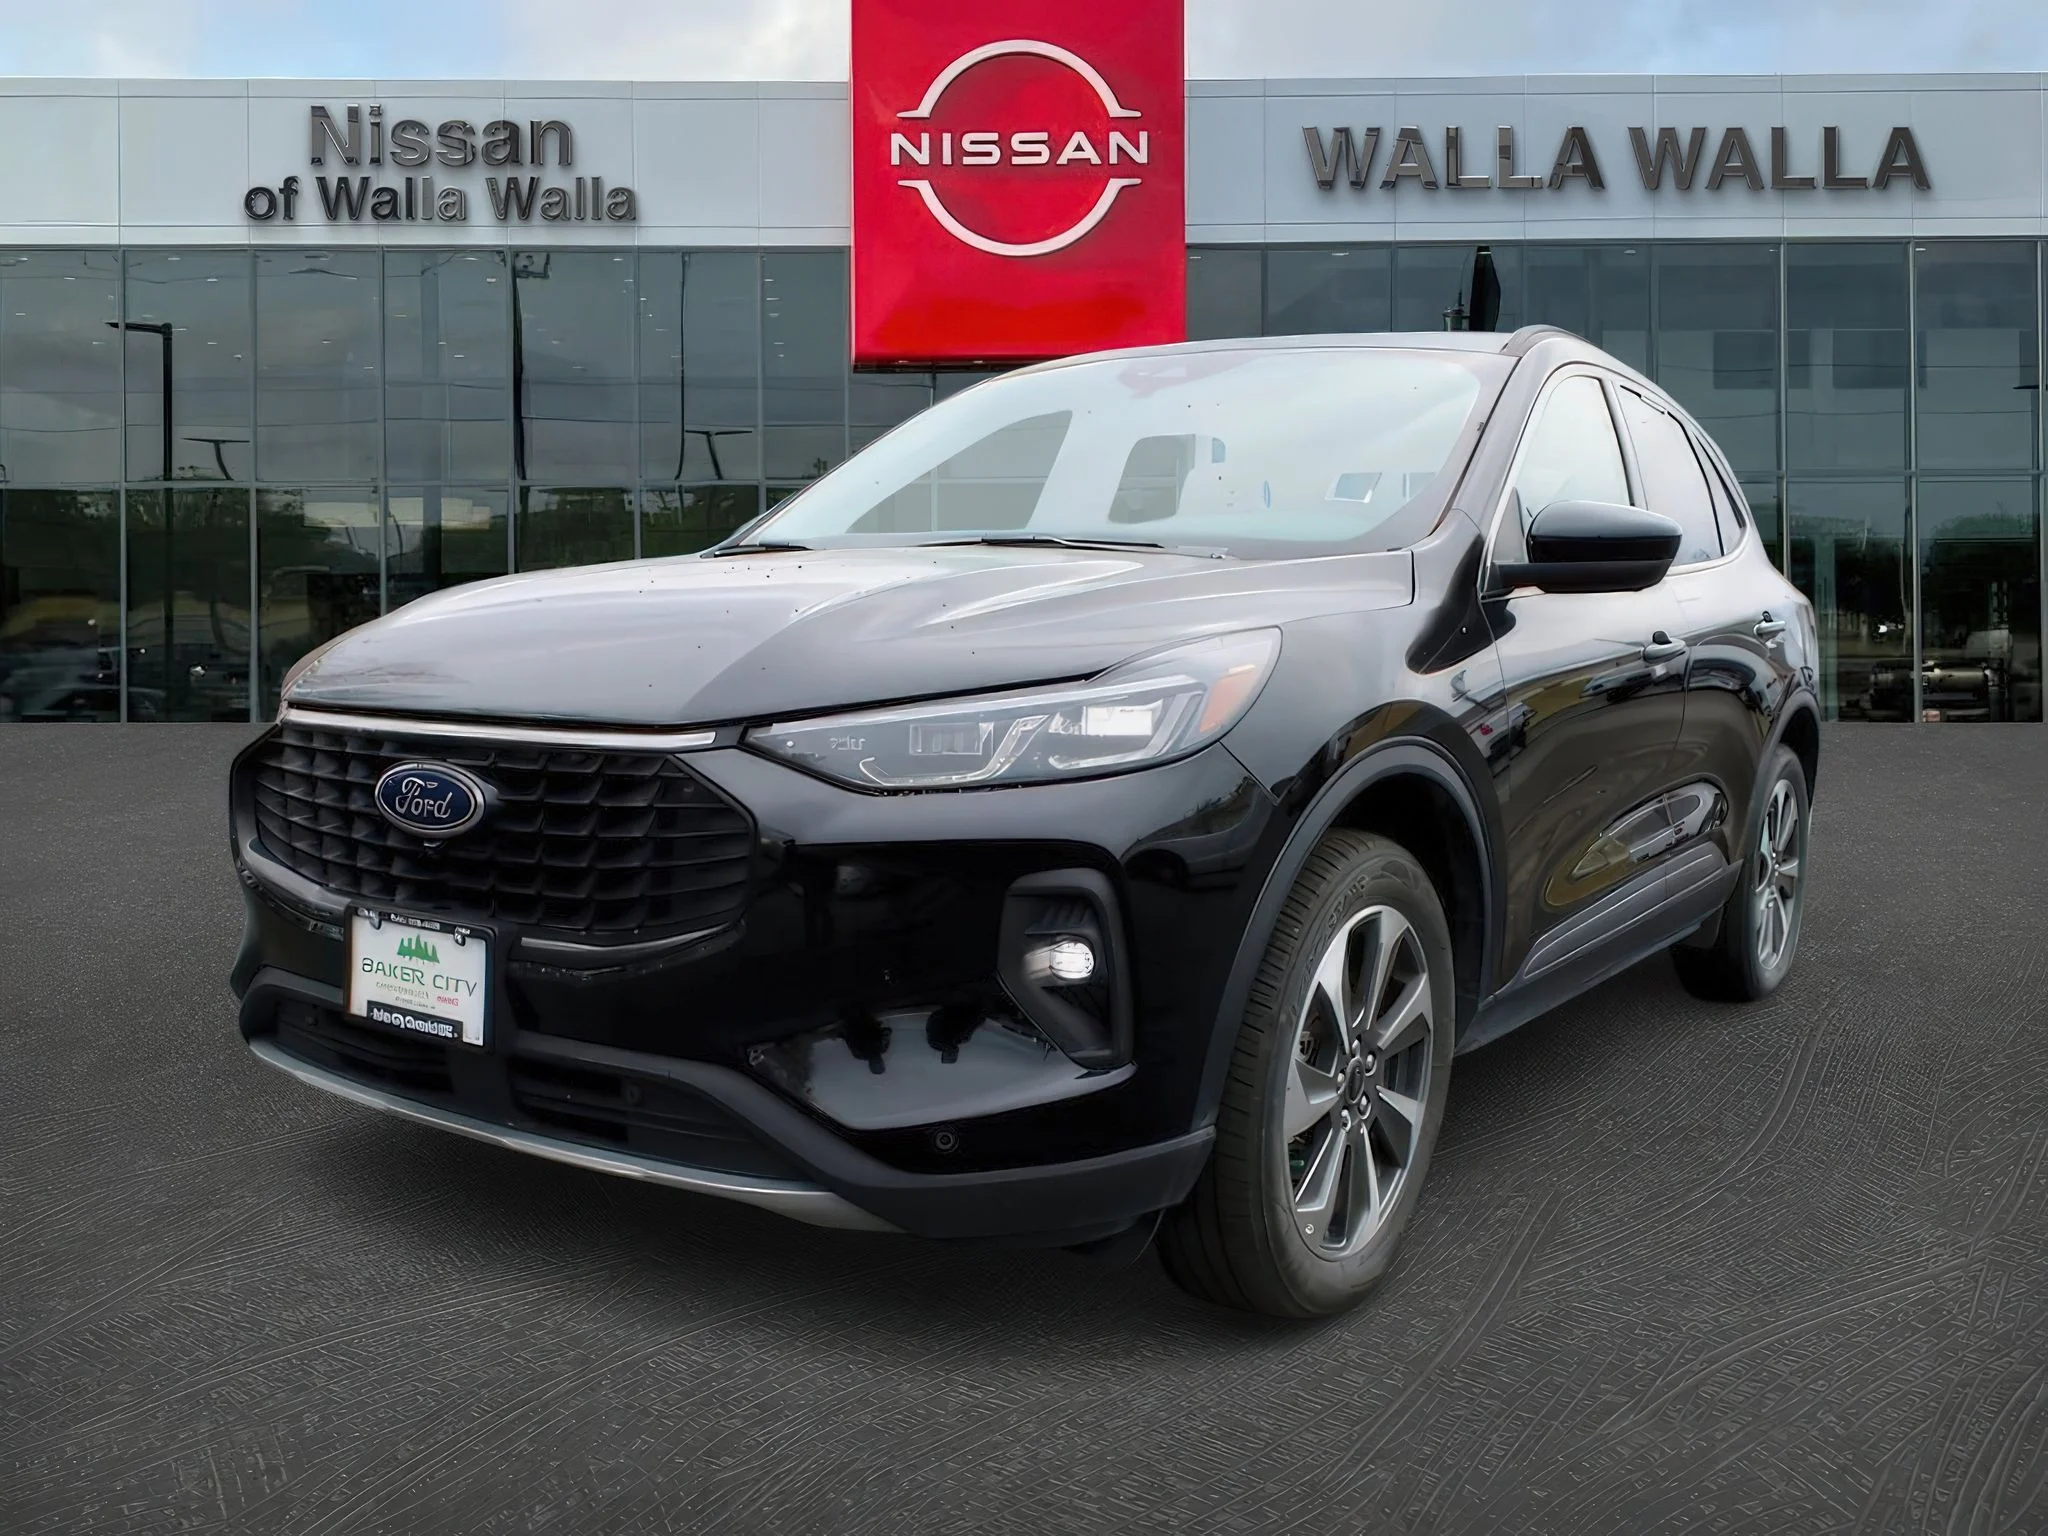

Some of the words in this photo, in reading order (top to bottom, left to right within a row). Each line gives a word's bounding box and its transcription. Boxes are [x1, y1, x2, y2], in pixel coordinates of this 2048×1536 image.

[311, 103, 575, 167] Nissan
[890, 131, 1148, 166] NISSAN
[1302, 126, 1605, 190] WALLA
[1628, 126, 1932, 190] WALLA
[244, 176, 301, 221] of
[315, 176, 467, 221] Walla
[485, 176, 638, 221] Walla
[395, 777, 453, 818] Ford
[361, 957, 425, 986] BAKER
[432, 974, 478, 998] CITY
